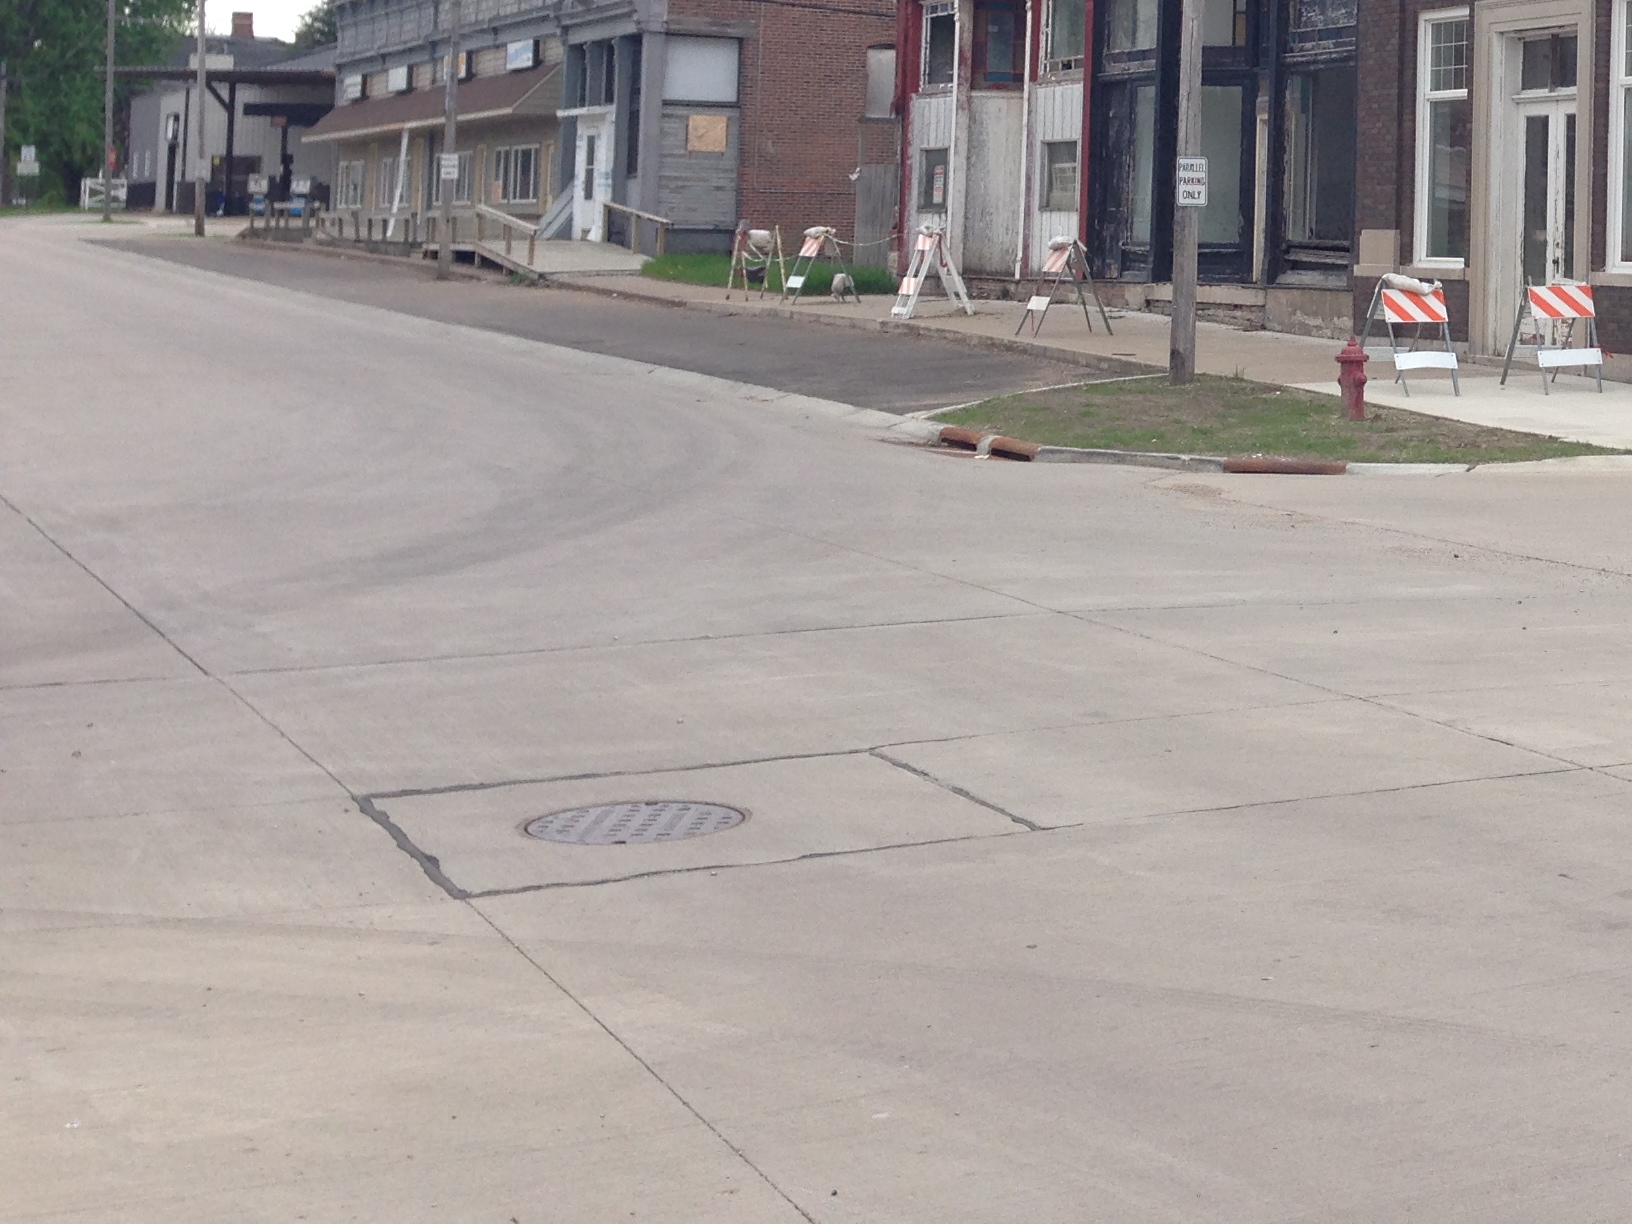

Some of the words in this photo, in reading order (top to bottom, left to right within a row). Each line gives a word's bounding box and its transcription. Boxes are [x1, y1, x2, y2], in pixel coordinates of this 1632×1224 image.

[1179, 163, 1206, 172] PARALLEL
[1179, 177, 1206, 186] PARKING
[1182, 190, 1202, 200] ONLY
